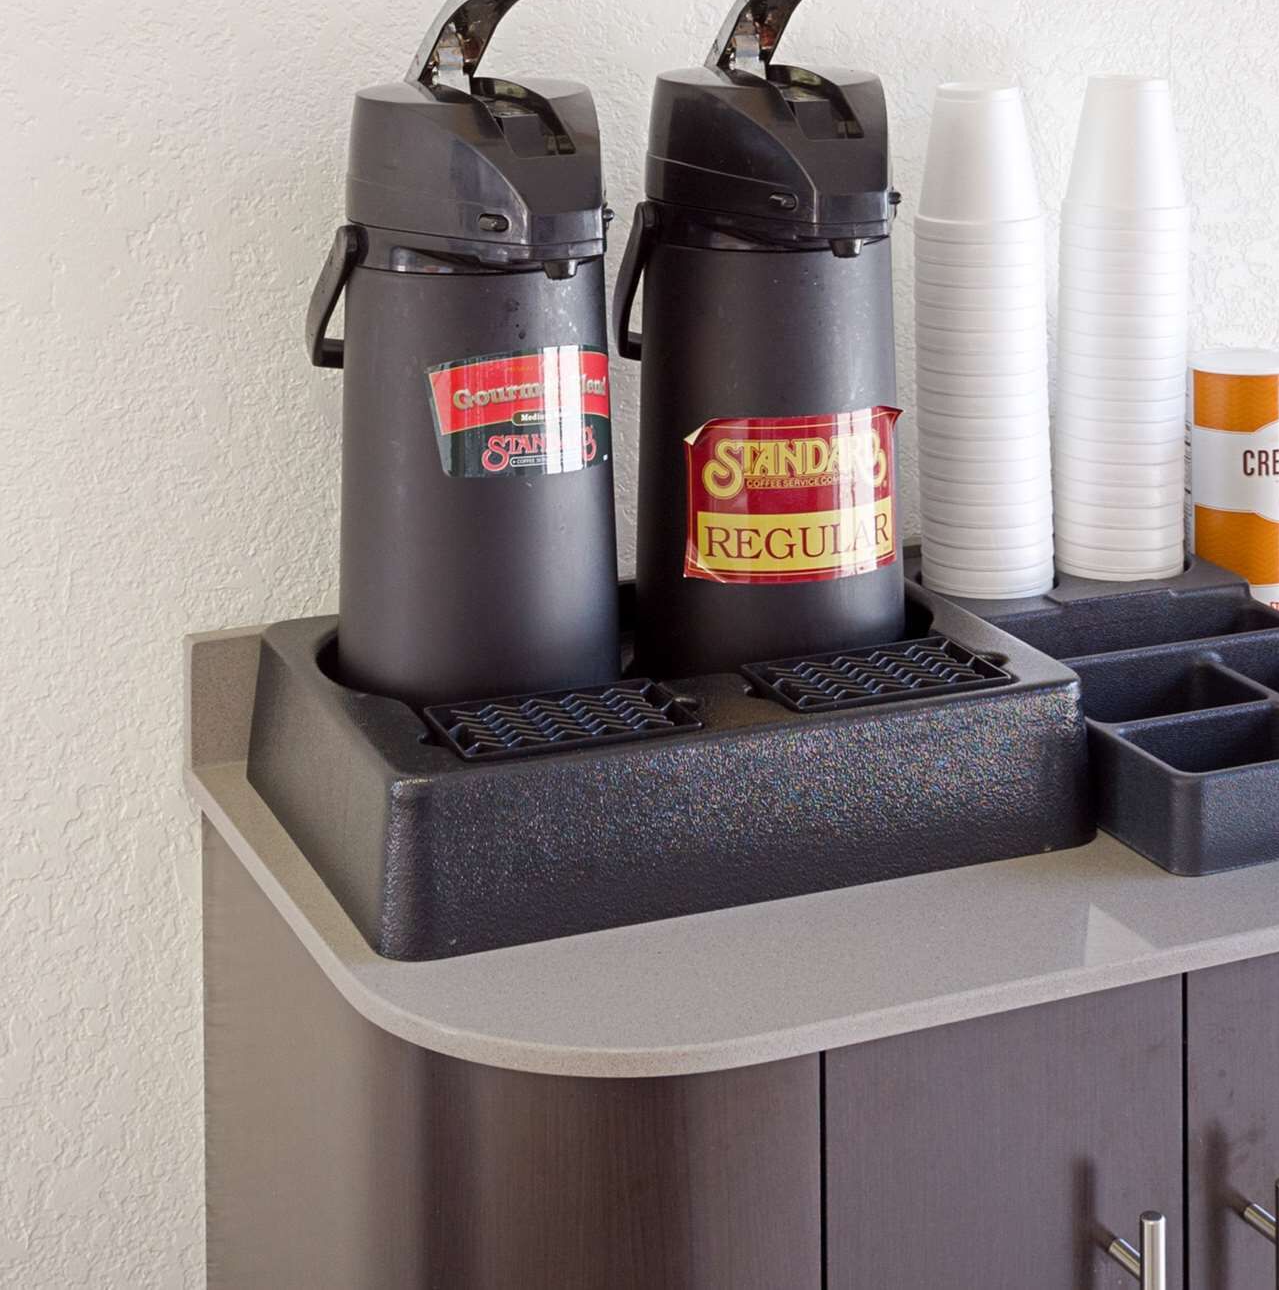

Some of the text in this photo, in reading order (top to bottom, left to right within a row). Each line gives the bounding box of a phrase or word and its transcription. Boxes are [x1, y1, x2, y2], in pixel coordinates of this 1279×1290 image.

[453, 381, 554, 411] Gourm
[482, 424, 597, 471] STAND
[746, 478, 782, 489] COFFEE
[704, 513, 889, 560] REGULAR
